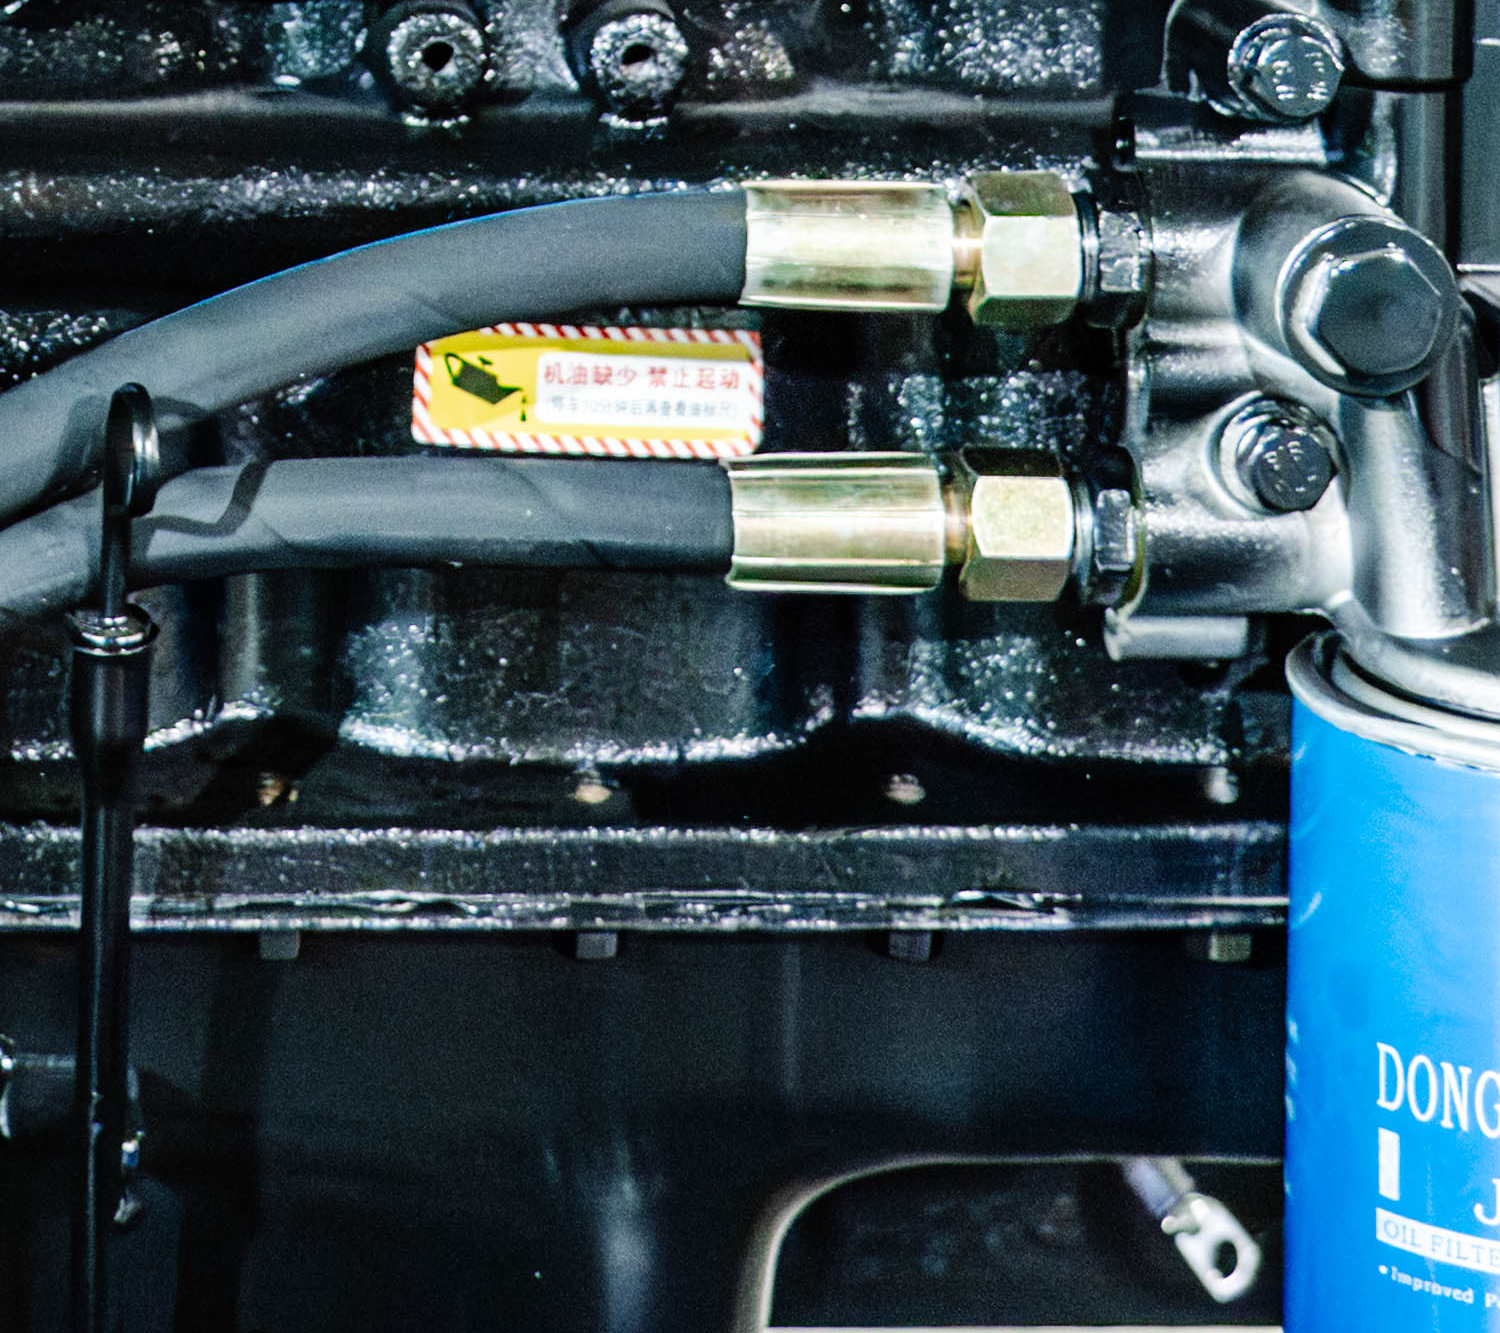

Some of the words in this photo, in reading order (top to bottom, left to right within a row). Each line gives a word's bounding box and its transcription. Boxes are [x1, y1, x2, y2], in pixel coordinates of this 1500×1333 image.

[544, 361, 638, 387] 机油缺少
[648, 366, 740, 392] 禁止起动
[1382, 1218, 1423, 1249] OIL
[1390, 1265, 1475, 1306] Improved
